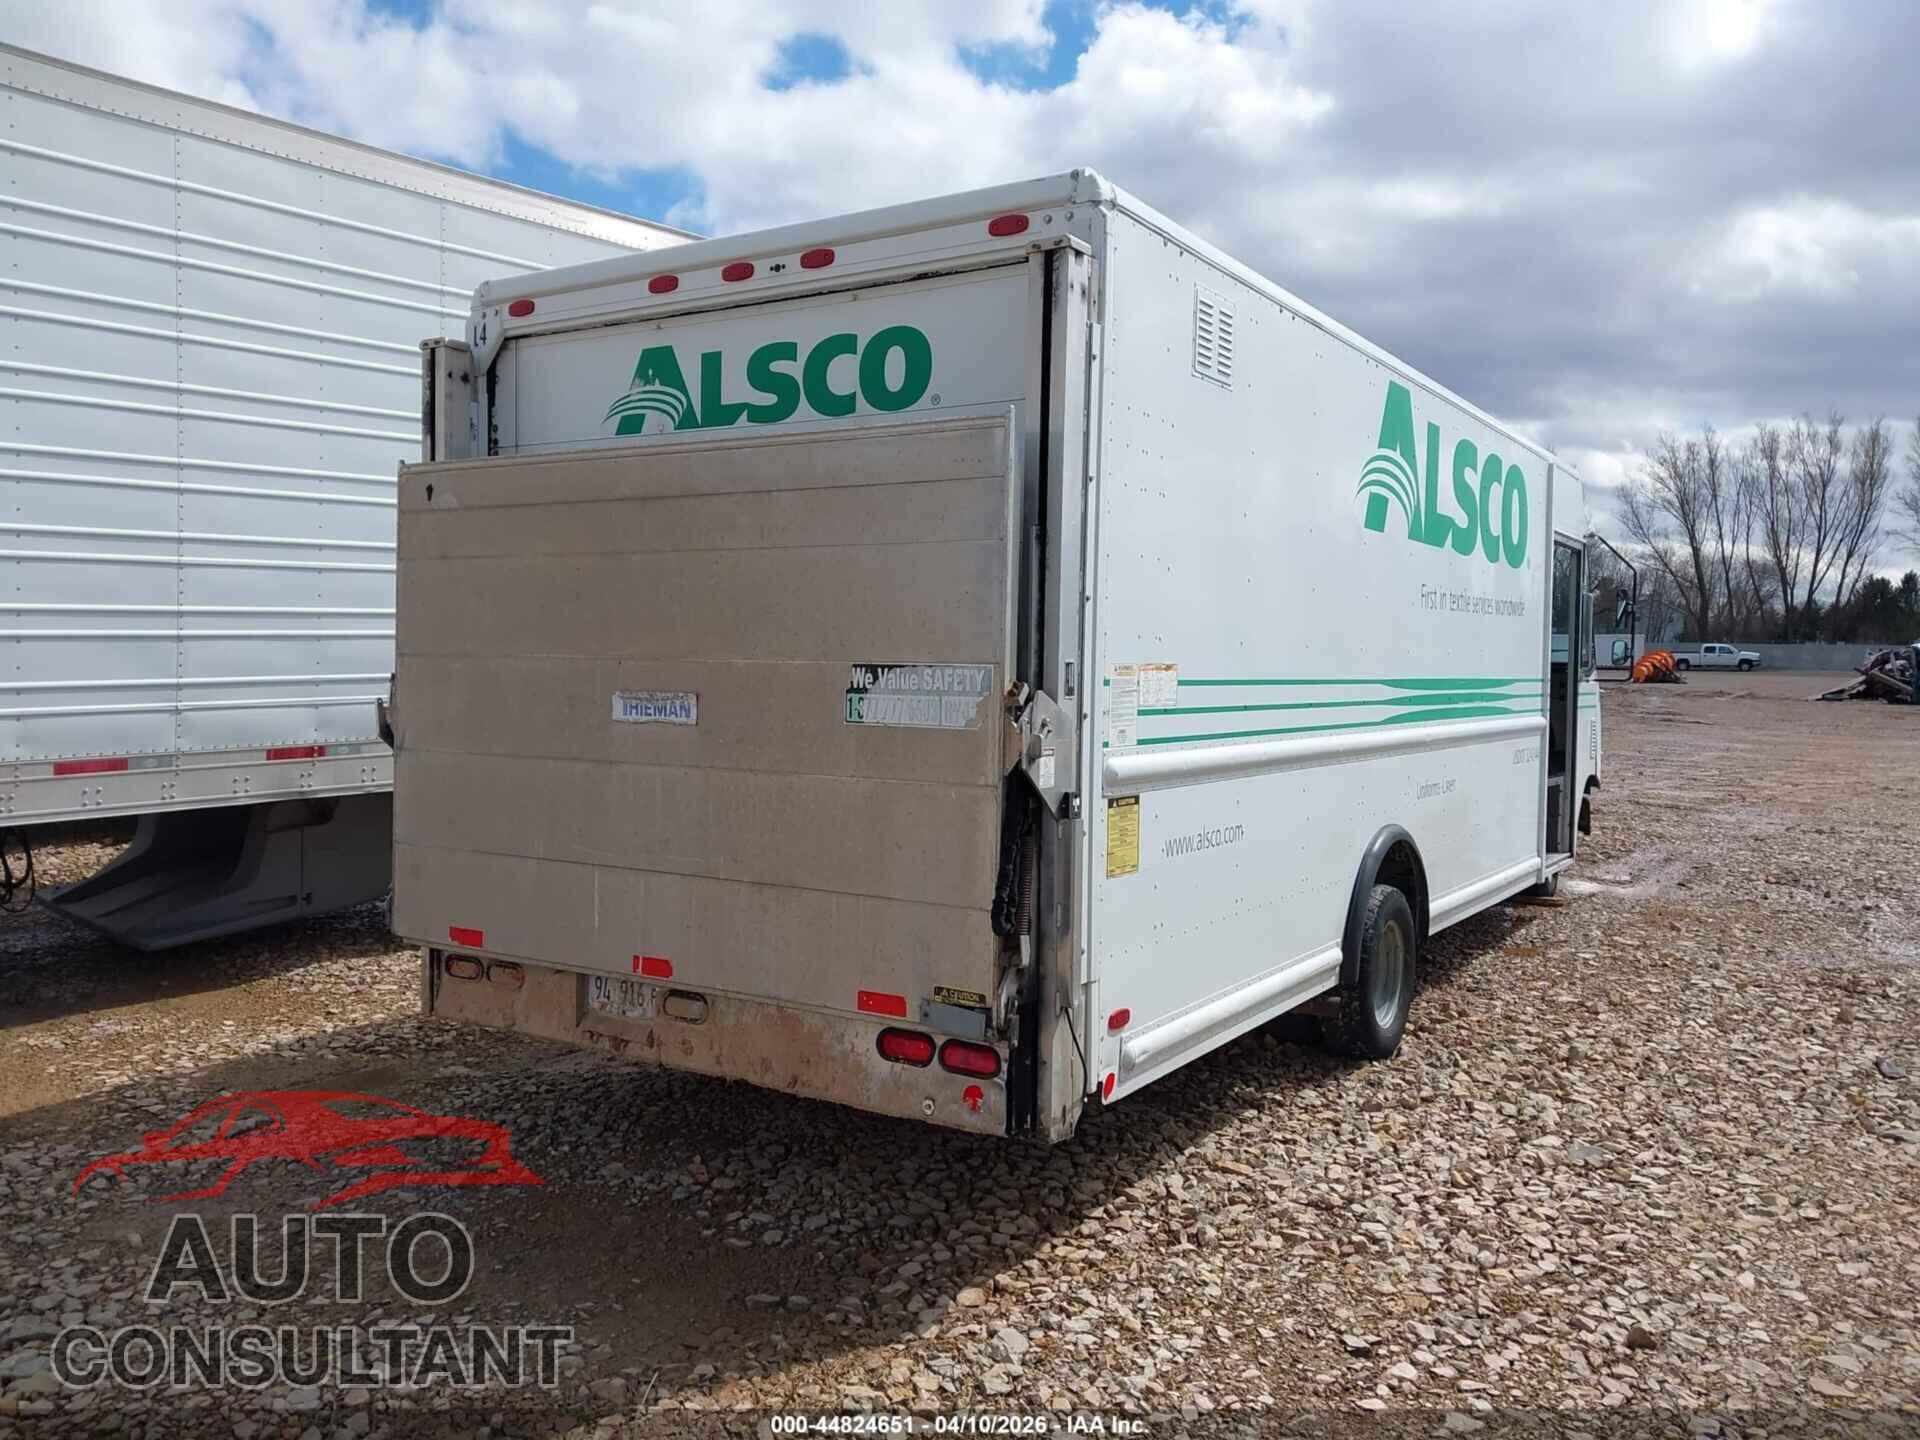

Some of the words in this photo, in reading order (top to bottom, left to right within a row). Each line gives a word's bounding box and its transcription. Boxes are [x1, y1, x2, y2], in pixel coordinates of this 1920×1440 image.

[602, 325, 933, 436] ALSCO
[1357, 379, 1529, 569] ALSCO
[851, 667, 874, 689] We
[878, 667, 919, 691] Value
[923, 669, 985, 692] SAFETY
[1164, 824, 1244, 857] www.alsco.com
